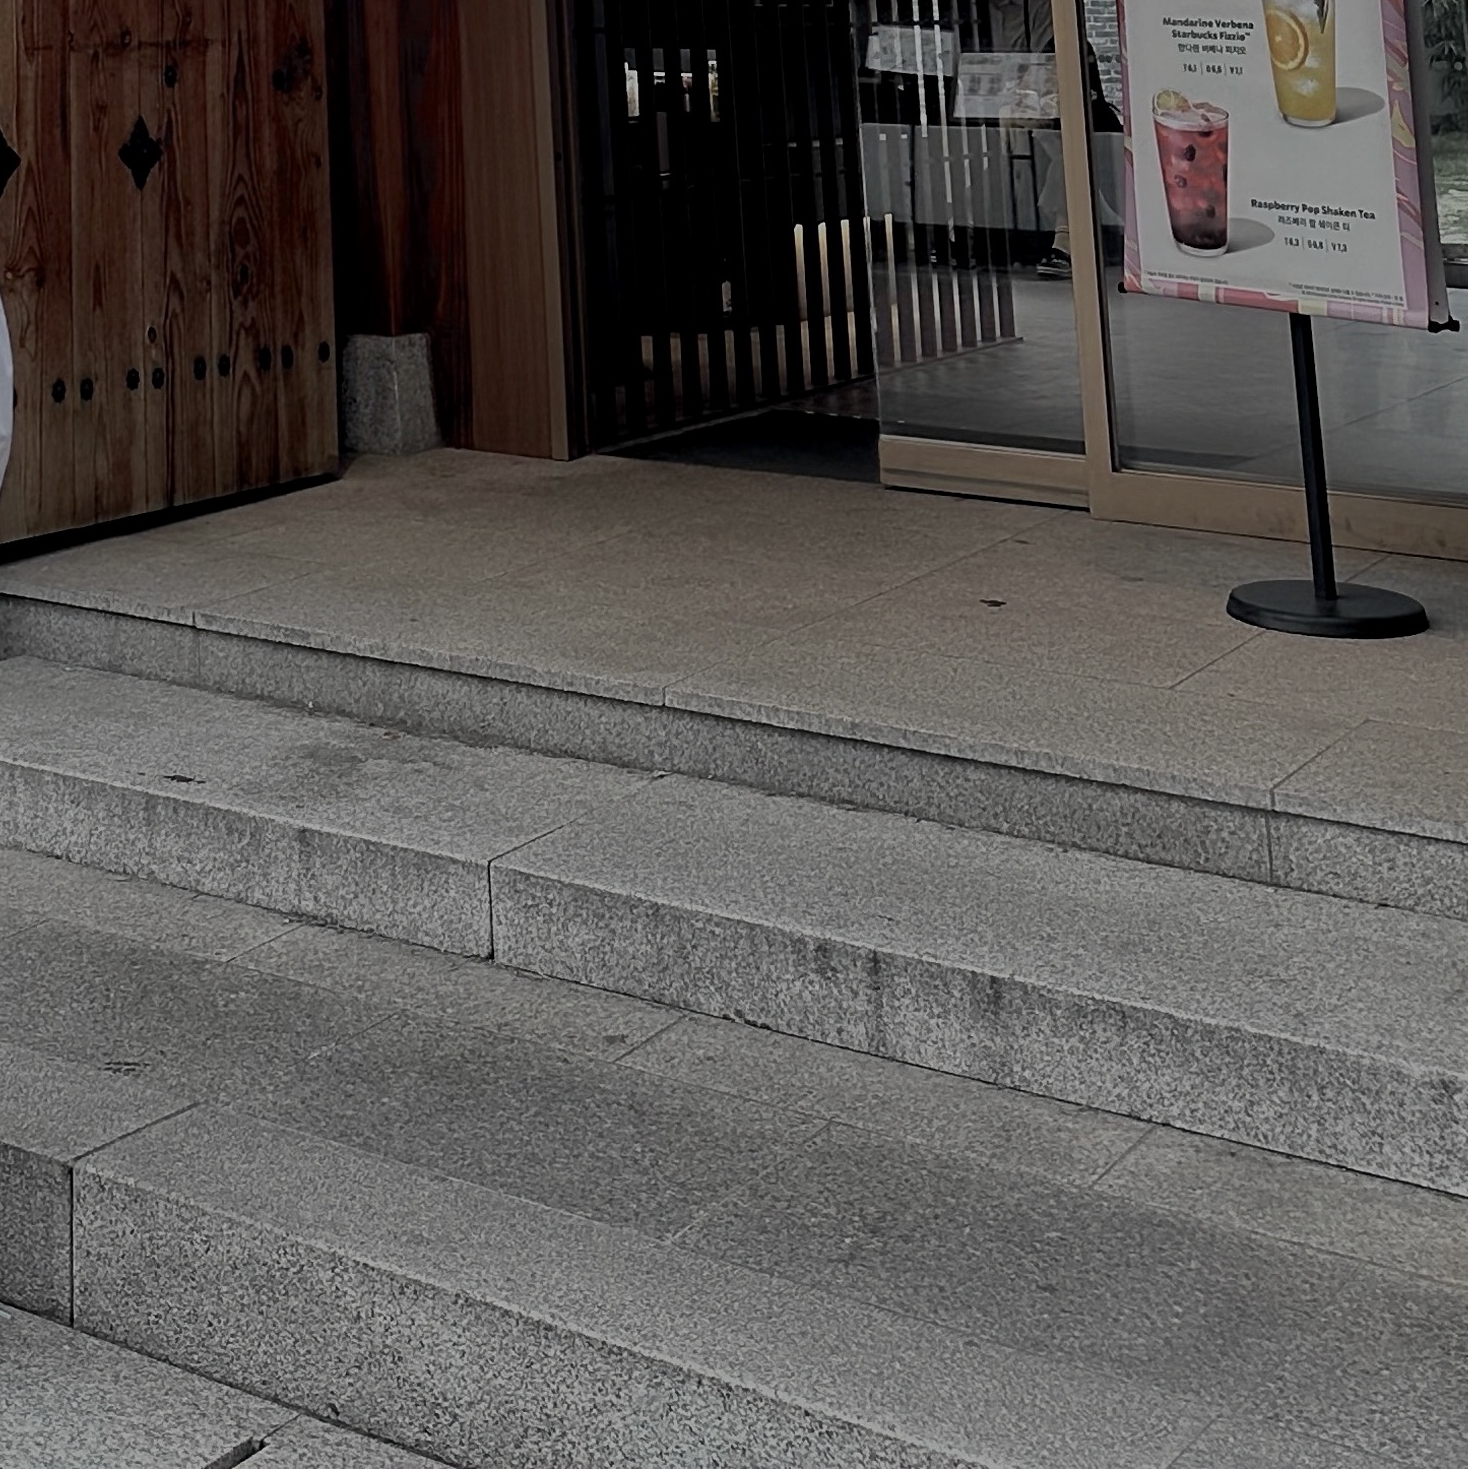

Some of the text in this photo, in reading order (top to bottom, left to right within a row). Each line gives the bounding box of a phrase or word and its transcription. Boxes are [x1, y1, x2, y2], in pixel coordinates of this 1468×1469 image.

[1163, 17, 1254, 29] Mandarine Verbena
[1172, 30, 1218, 40] Starbucks
[1251, 199, 1376, 220] Raspberry Pop Shaken Tea
